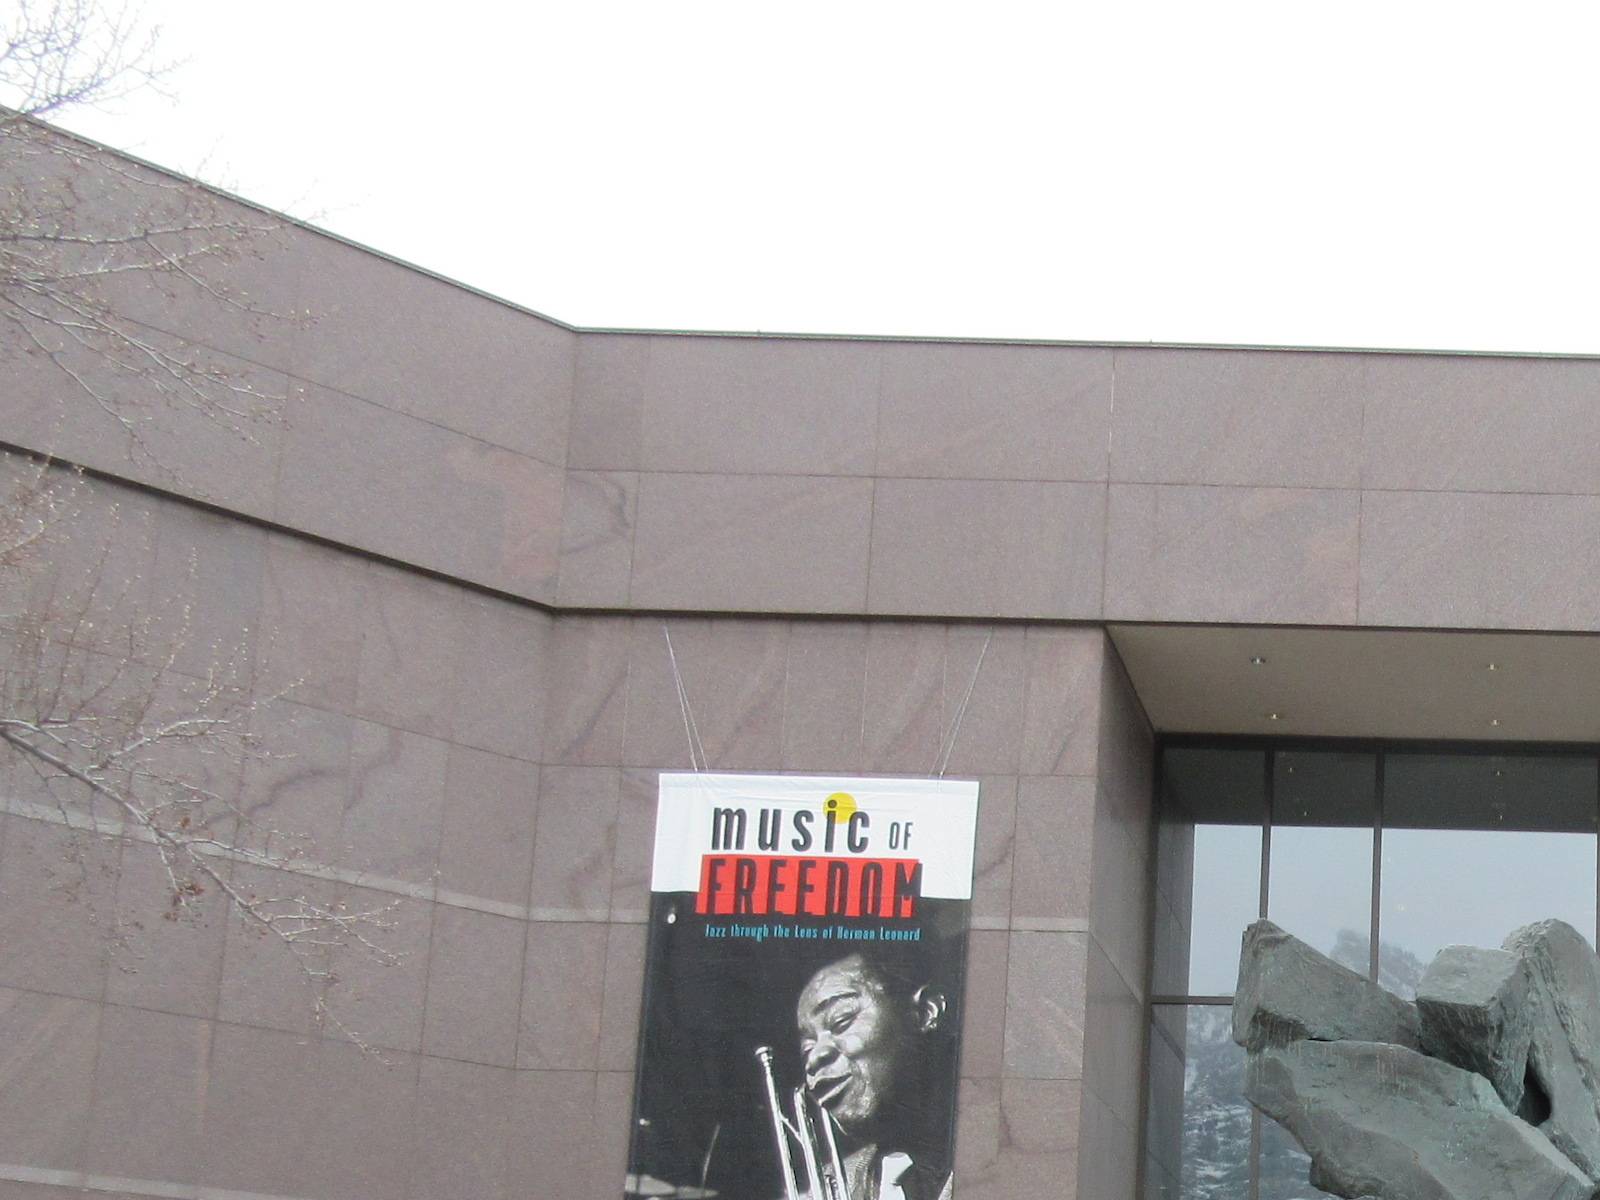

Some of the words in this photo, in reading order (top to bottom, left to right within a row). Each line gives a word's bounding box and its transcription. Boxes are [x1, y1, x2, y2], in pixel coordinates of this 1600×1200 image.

[711, 799, 870, 853] music
[888, 822, 914, 850] OF
[704, 857, 923, 917] FREEDOM
[704, 924, 726, 938] Jazz
[730, 924, 769, 942] through
[773, 925, 790, 938] the
[822, 926, 834, 939] of
